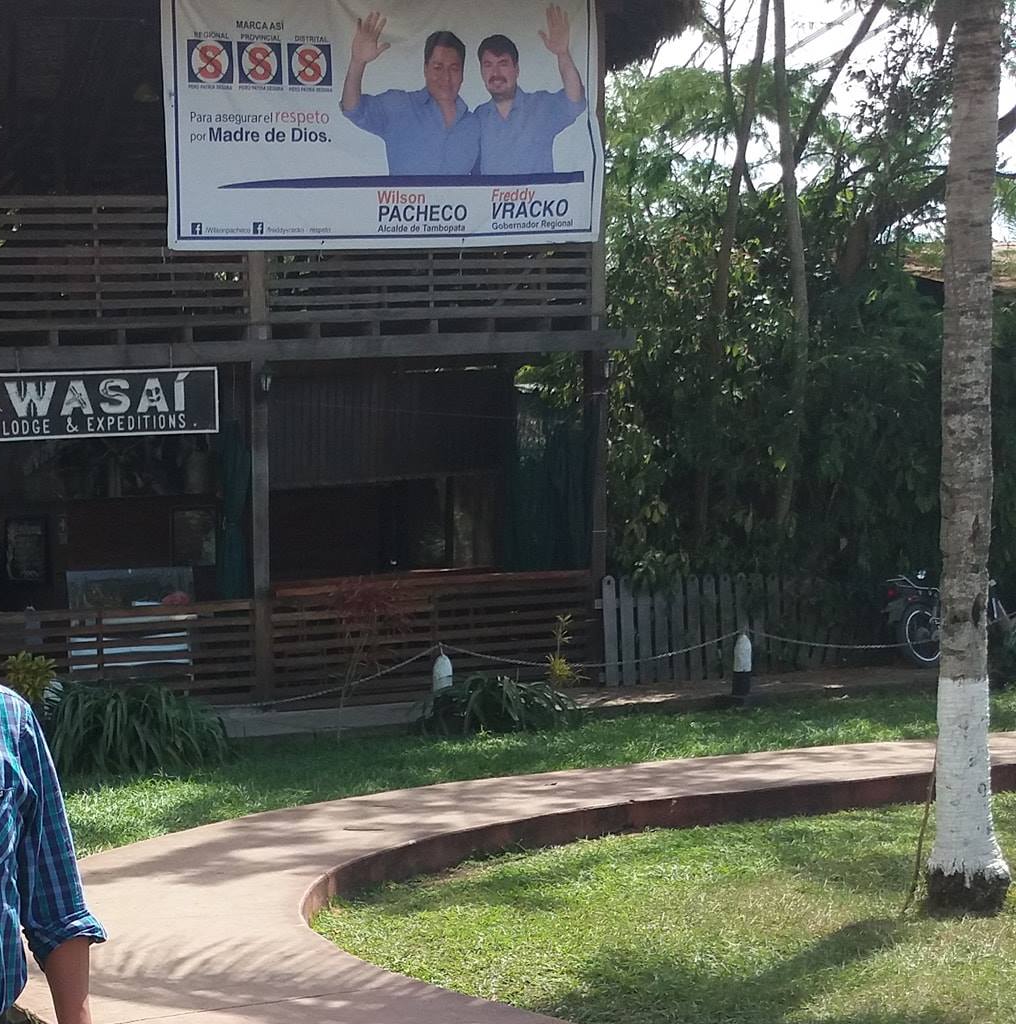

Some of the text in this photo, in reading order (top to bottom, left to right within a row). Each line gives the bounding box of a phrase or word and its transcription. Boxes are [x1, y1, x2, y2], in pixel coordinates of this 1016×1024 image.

[236, 20, 268, 30] MARCA
[193, 31, 230, 39] REGIONAL
[240, 33, 281, 41] PROVINCIAL
[294, 35, 328, 43] DISTRITAL
[190, 110, 330, 126] Para asegurar el respeto
[190, 127, 332, 143] por Madre de Dios.
[377, 190, 426, 204] Wilson
[491, 187, 535, 204] Freddy
[378, 204, 468, 222] PACHECO
[491, 198, 569, 219] VRACKO
[377, 223, 466, 234] Alcalde de Tambopata
[491, 218, 574, 230] Gobernador Regional
[4, 371, 190, 417] WASAÍ
[2, 413, 186, 436] LODGE & EXPEDITIONS
